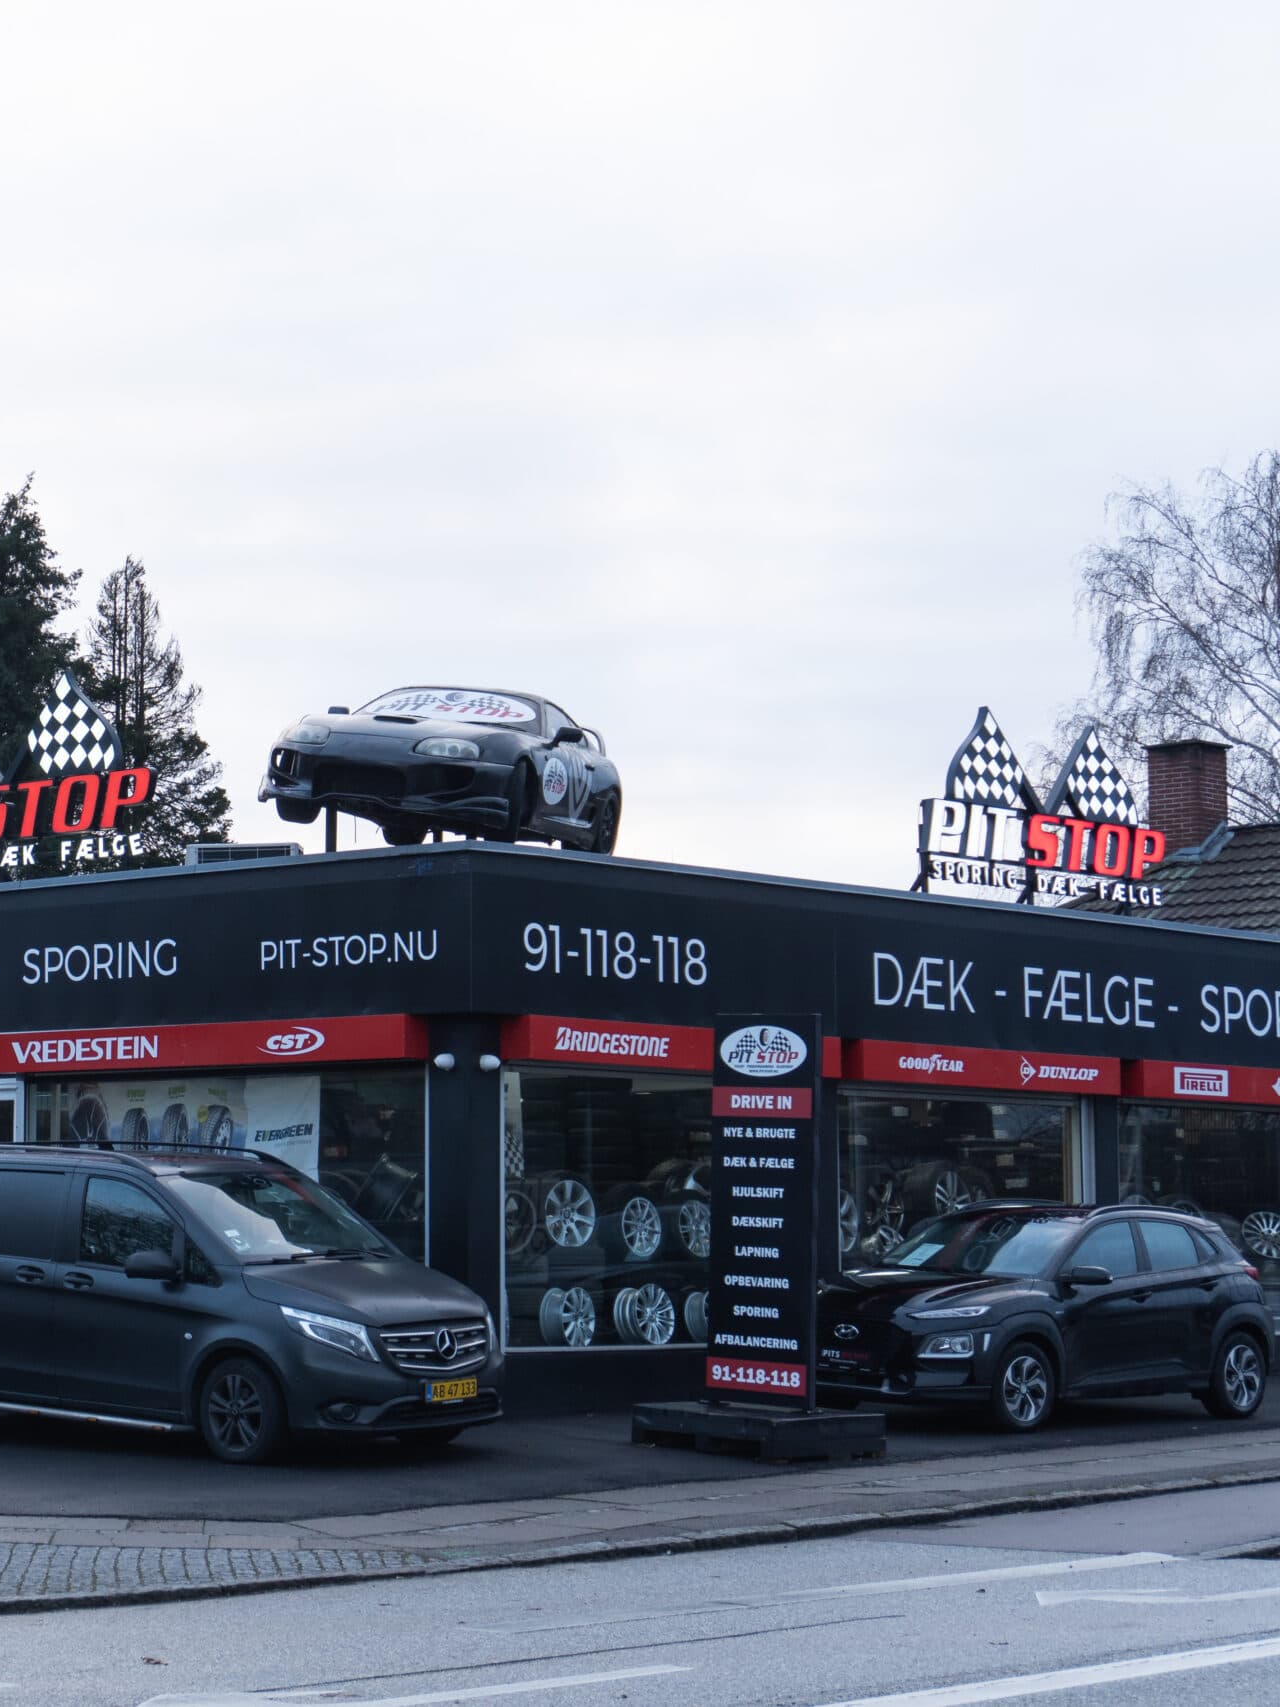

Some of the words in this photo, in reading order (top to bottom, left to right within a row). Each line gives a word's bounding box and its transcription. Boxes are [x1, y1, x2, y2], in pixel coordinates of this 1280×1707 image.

[435, 704, 524, 718] STOP
[60, 834, 144, 862] FÆLGE
[928, 799, 1018, 861] PIT
[1026, 813, 1166, 880] STOP
[932, 861, 1018, 889] SPORING
[1037, 874, 1080, 897] DÆK
[1099, 883, 1162, 905] FÆLGE
[261, 929, 438, 971] PIT-STOP.NU
[523, 922, 708, 985] 91-118-118
[22, 938, 177, 985] SPORING
[873, 951, 975, 1014] DÆK
[1023, 966, 1156, 1029] FÆLGE
[12, 1035, 158, 1064] VREDESTEIN
[266, 1033, 311, 1051] CST
[554, 1026, 669, 1058] BRIDGESTONE
[728, 1051, 754, 1063] PIT
[756, 1051, 799, 1063] STOP
[1038, 1065, 1099, 1081] DUNLOP
[1180, 1072, 1223, 1092] PIRELLI
[731, 1095, 774, 1109] DRIVE
[776, 1096, 792, 1110] IN
[255, 1123, 314, 1142] EVERGREEN
[723, 1128, 743, 1138] NYE
[745, 1128, 754, 1138] &
[755, 1128, 796, 1140] BRUGTE
[723, 1157, 748, 1168] DÆK
[749, 1157, 758, 1168] &
[759, 1157, 795, 1169] FÆLGE
[732, 1186, 784, 1199] HJULSKIFT
[731, 1216, 784, 1229] DÆKSKIFT
[734, 1246, 779, 1259] LAPNING
[724, 1275, 789, 1289] OPBEVARING
[733, 1306, 779, 1319] SPORING
[714, 1333, 798, 1350] AFBALANCERING
[711, 1365, 800, 1388] 91-118-118
[433, 1385, 446, 1398] AB
[448, 1384, 459, 1396] 47
[461, 1381, 476, 1395] 133
